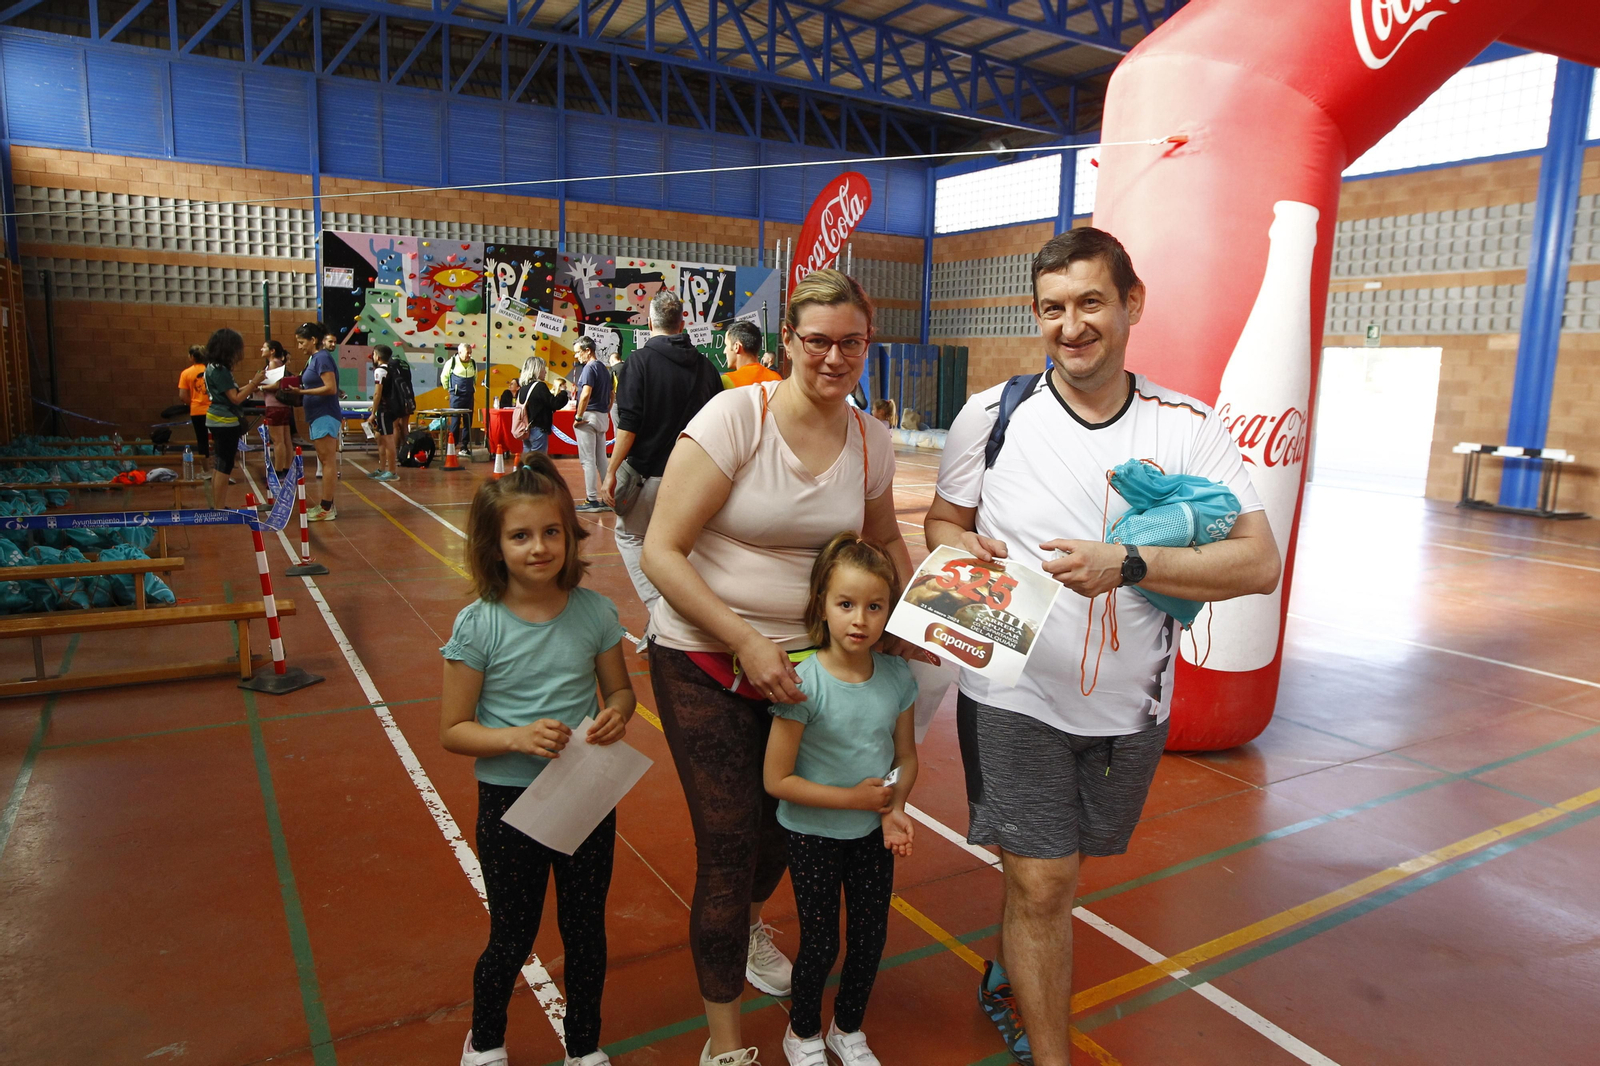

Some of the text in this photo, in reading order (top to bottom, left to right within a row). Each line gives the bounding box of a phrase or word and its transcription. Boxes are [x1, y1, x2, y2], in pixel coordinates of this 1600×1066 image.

[540, 313, 562, 324] DORSALES
[540, 321, 560, 332] MILLAS
[72, 518, 120, 526] Ayuntamiento
[935, 560, 1019, 611] 525
[933, 610, 947, 618] enero
[946, 614, 960, 623] 2024
[979, 603, 1024, 630] XIII
[970, 625, 984, 635] DEL
[974, 617, 1020, 641] POPULAR
[977, 612, 1022, 636] CARRERA
[982, 625, 1019, 645] ESPARTANOS
[719, 1057, 735, 1065] FILA
